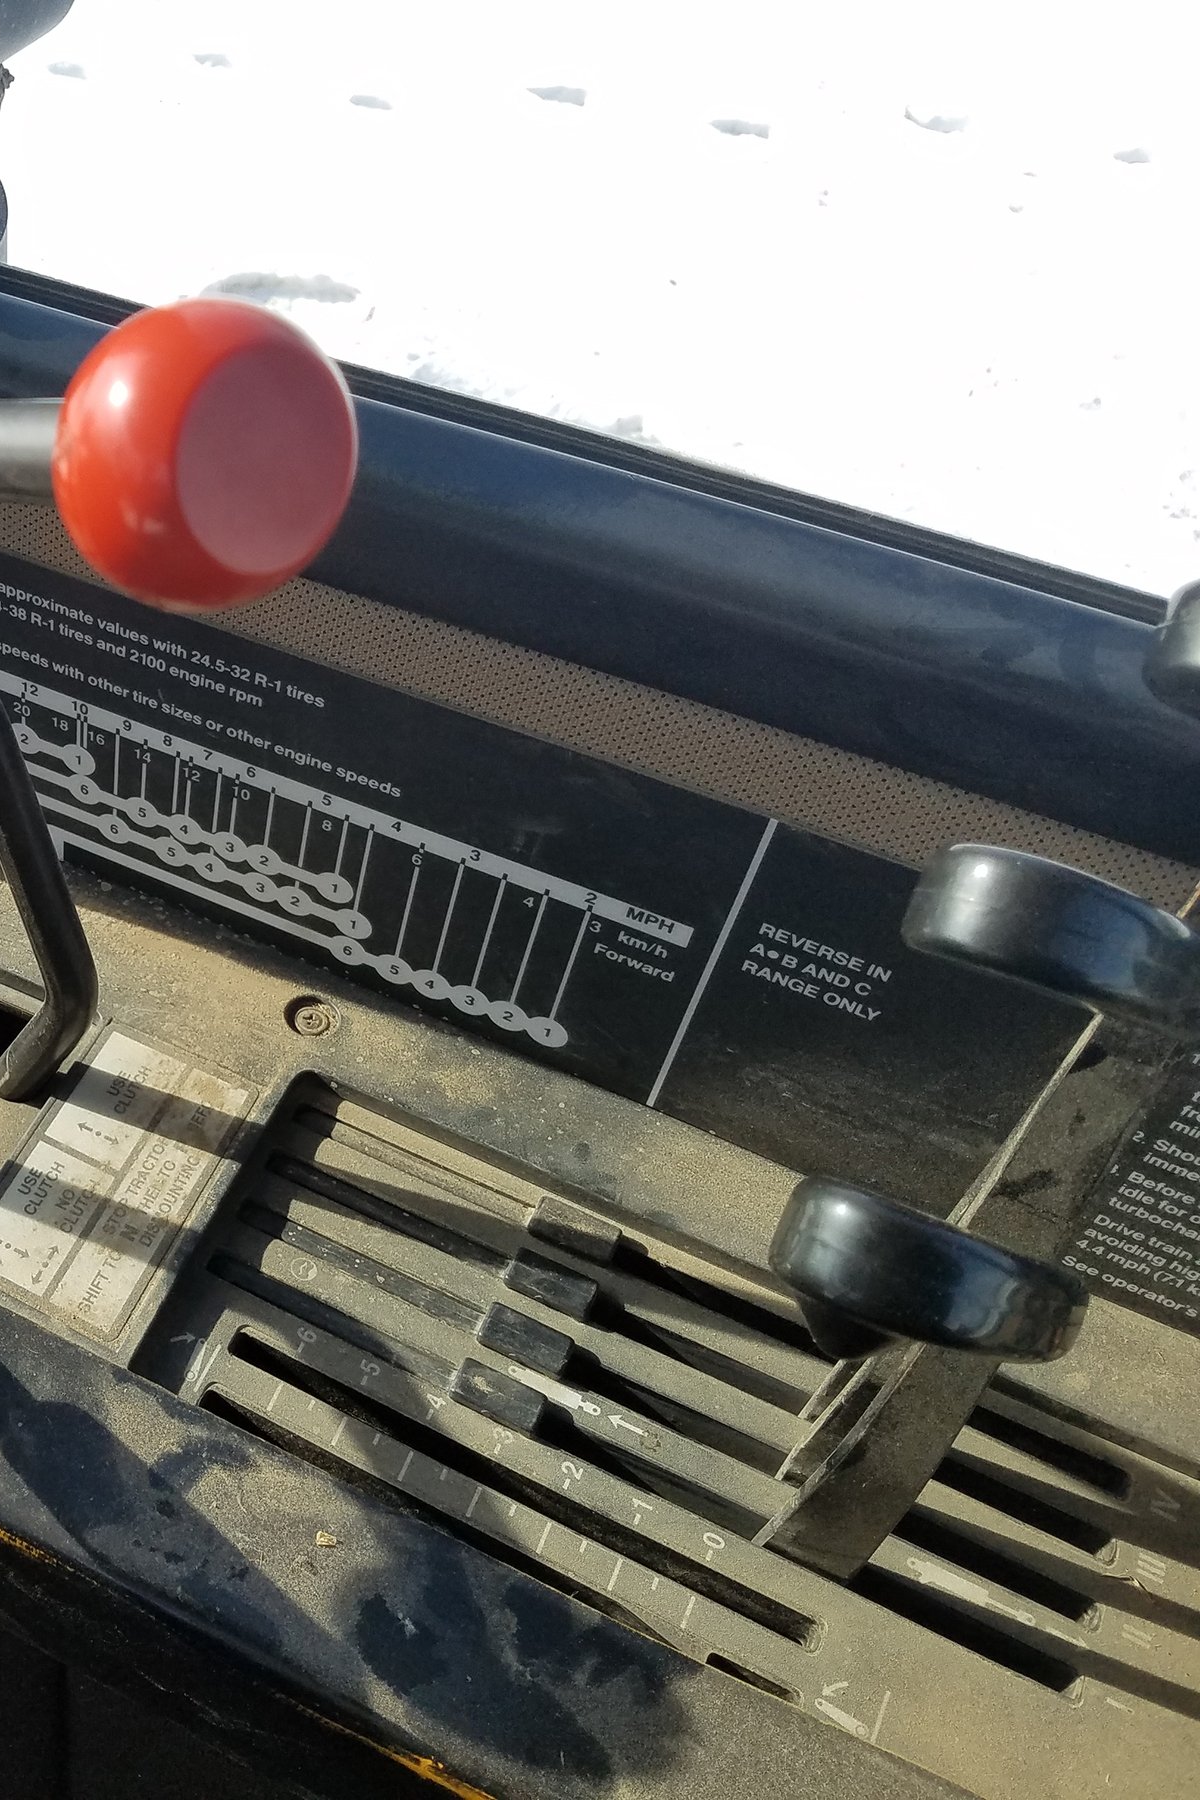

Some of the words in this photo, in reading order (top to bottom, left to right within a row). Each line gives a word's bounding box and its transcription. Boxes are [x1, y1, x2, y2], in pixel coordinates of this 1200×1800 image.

[30, 611, 55, 631] R-1
[58, 622, 94, 646] tires
[96, 636, 126, 658] and
[129, 649, 167, 674] 2100
[169, 663, 226, 694] engine
[229, 685, 264, 709] rpm
[97, 617, 150, 646] values
[152, 636, 188, 659] with
[190, 650, 251, 683] 24.5-32
[254, 672, 283, 694] R-1
[286, 684, 326, 709] tires
[20, 734, 29, 745] 2
[75, 755, 82, 765] 1
[52, 659, 84, 681] with
[88, 674, 129, 700] other
[132, 690, 158, 709] tire
[161, 702, 202, 726] sizes
[205, 718, 224, 733] or
[226, 726, 271, 752] other
[274, 742, 332, 774] engine
[336, 765, 402, 799] speeds
[13, 701, 31, 718] 20
[52, 717, 69, 732] 18
[88, 731, 105, 746] 16
[134, 748, 151, 764] 14
[182, 766, 201, 782] 12
[232, 785, 250, 801] 10
[321, 820, 333, 832] 8
[411, 853, 423, 866] 6
[522, 896, 535, 908] 4
[588, 920, 602, 933] 3
[617, 930, 669, 959] km/h
[21, 681, 39, 696] 12
[71, 701, 89, 715] 10
[122, 719, 132, 731] 9
[162, 735, 173, 747] 8
[202, 749, 213, 761] 7
[246, 766, 256, 778] 6
[321, 794, 333, 806] 5
[390, 820, 402, 833] 4
[469, 849, 481, 862] 3
[584, 892, 598, 905] 2
[625, 906, 675, 935] MPH
[80, 784, 89, 795] 6
[137, 807, 147, 818] 5
[179, 824, 189, 835] 4
[225, 842, 235, 853] 3
[259, 855, 269, 867] 2
[331, 883, 339, 894] 1
[110, 824, 119, 835] 6
[166, 846, 176, 858] 5
[204, 862, 214, 873] 4
[255, 882, 265, 893] 3
[290, 896, 300, 907] 2
[350, 919, 357, 930] 1
[593, 943, 676, 983] Forward
[758, 922, 866, 973] REVERSE
[866, 963, 893, 983] IN
[342, 945, 353, 956] 6
[389, 964, 400, 976] 5
[423, 979, 435, 990] 4
[464, 995, 476, 1007] 3
[502, 1011, 514, 1023] 2
[543, 1027, 552, 1038] 1
[741, 959, 821, 999] RANGE
[823, 991, 882, 1022] ONLY
[801, 962, 851, 989] AND
[854, 981, 873, 997] C
[106, 1070, 133, 1097] USE
[114, 1064, 153, 1115] CLUTCH
[17, 1166, 44, 1196] USE
[24, 1160, 66, 1216] CLUTCH
[1127, 1171, 1196, 1205] Before
[1142, 1152, 1200, 1182] imme
[54, 1188, 76, 1211] NO
[102, 1197, 128, 1236] STOP
[1118, 1183, 1155, 1205] idle
[1158, 1200, 1188, 1217] for
[1084, 1228, 1167, 1267] avoiding
[1094, 1214, 1146, 1241] Drive
[1148, 1236, 1193, 1261] train
[1061, 1255, 1099, 1276] See
[1101, 1273, 1198, 1318] operator's
[1076, 1239, 1105, 1256] 4.4
[1106, 1252, 1151, 1275] mph
[1153, 1270, 1185, 1288] (7.1
[78, 1269, 109, 1314] SHIFT
[360, 1359, 381, 1376] 5
[426, 1392, 447, 1409] 4
[561, 1461, 584, 1481] 2
[632, 1497, 653, 1513] 1
[702, 1532, 726, 1550] 0
